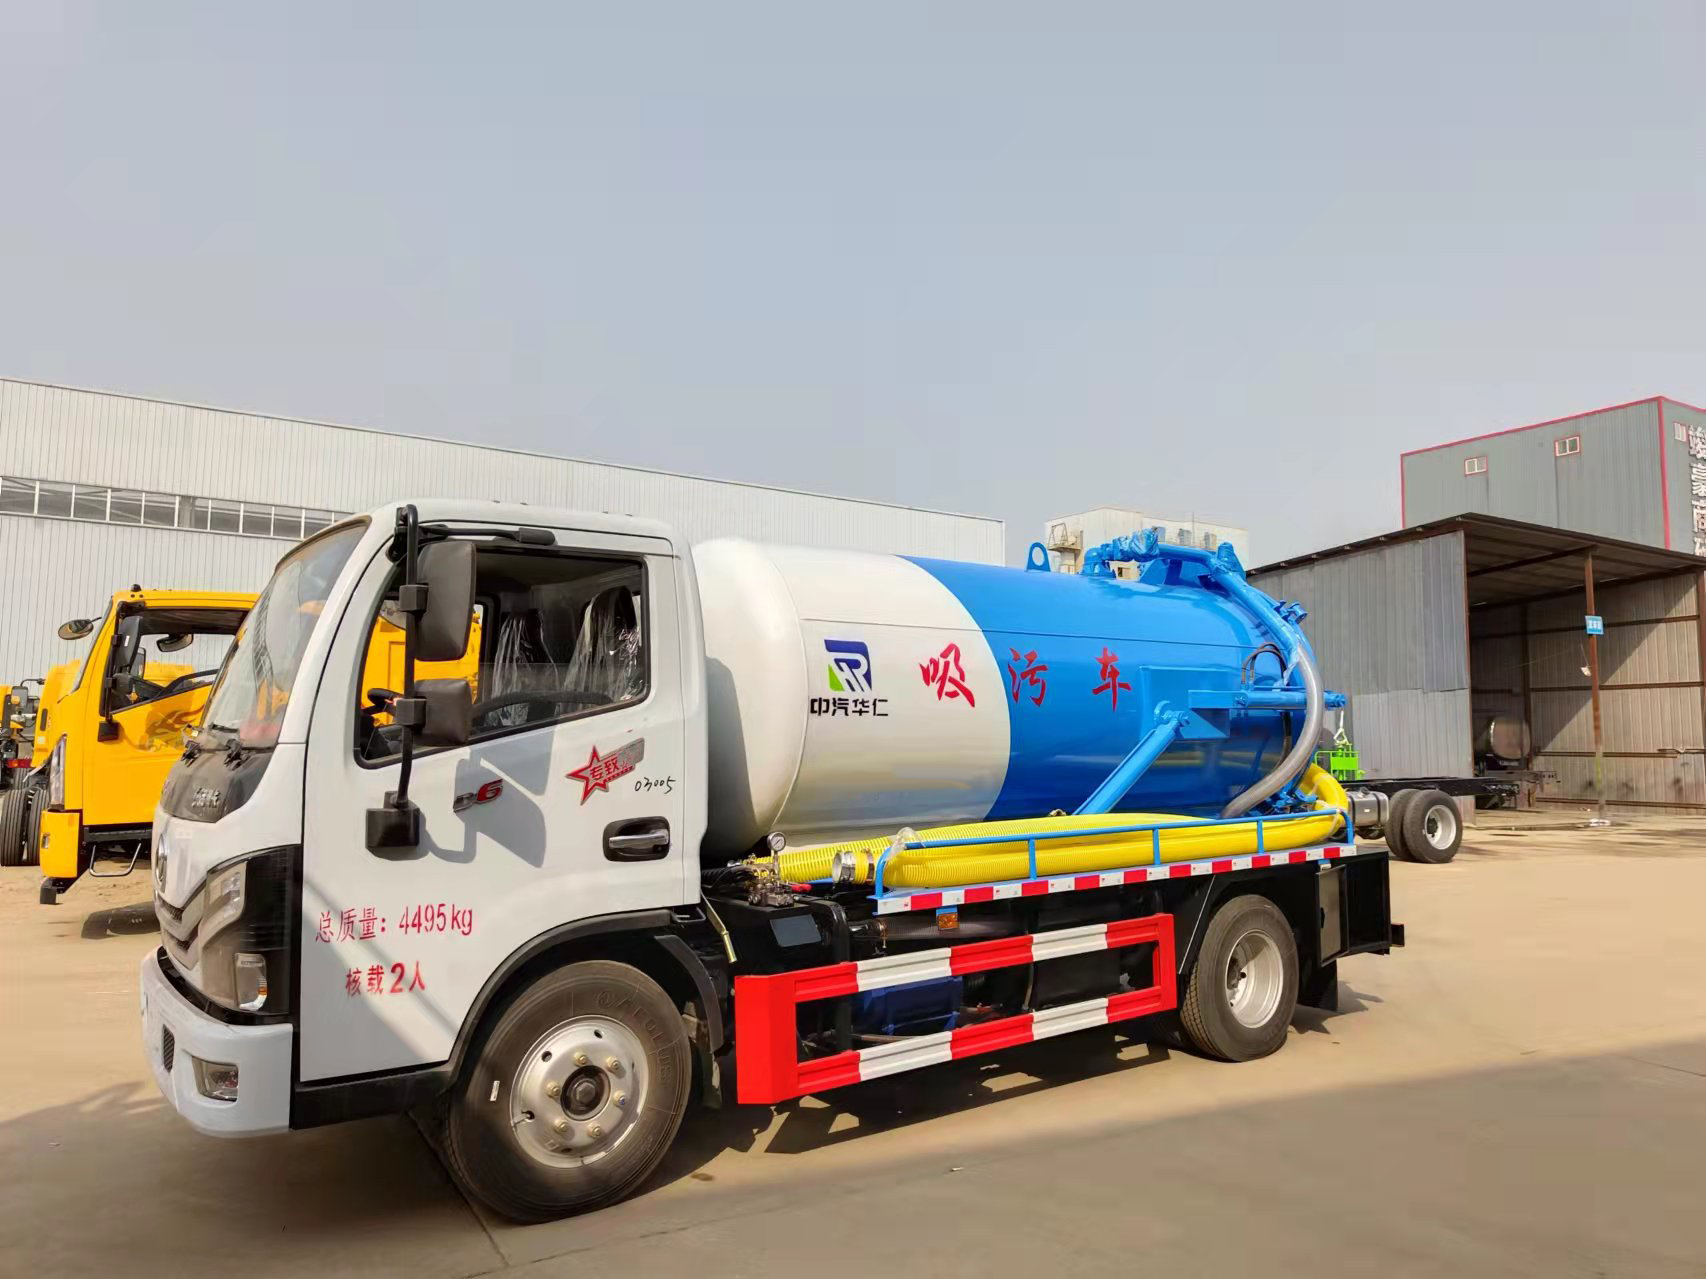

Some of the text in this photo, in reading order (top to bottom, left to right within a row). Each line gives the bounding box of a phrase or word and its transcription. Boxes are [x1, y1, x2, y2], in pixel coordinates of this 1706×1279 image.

[919, 643, 1132, 712] 吸污车
[810, 697, 889, 716] 中汽华仁
[345, 960, 426, 997] 核载2人
